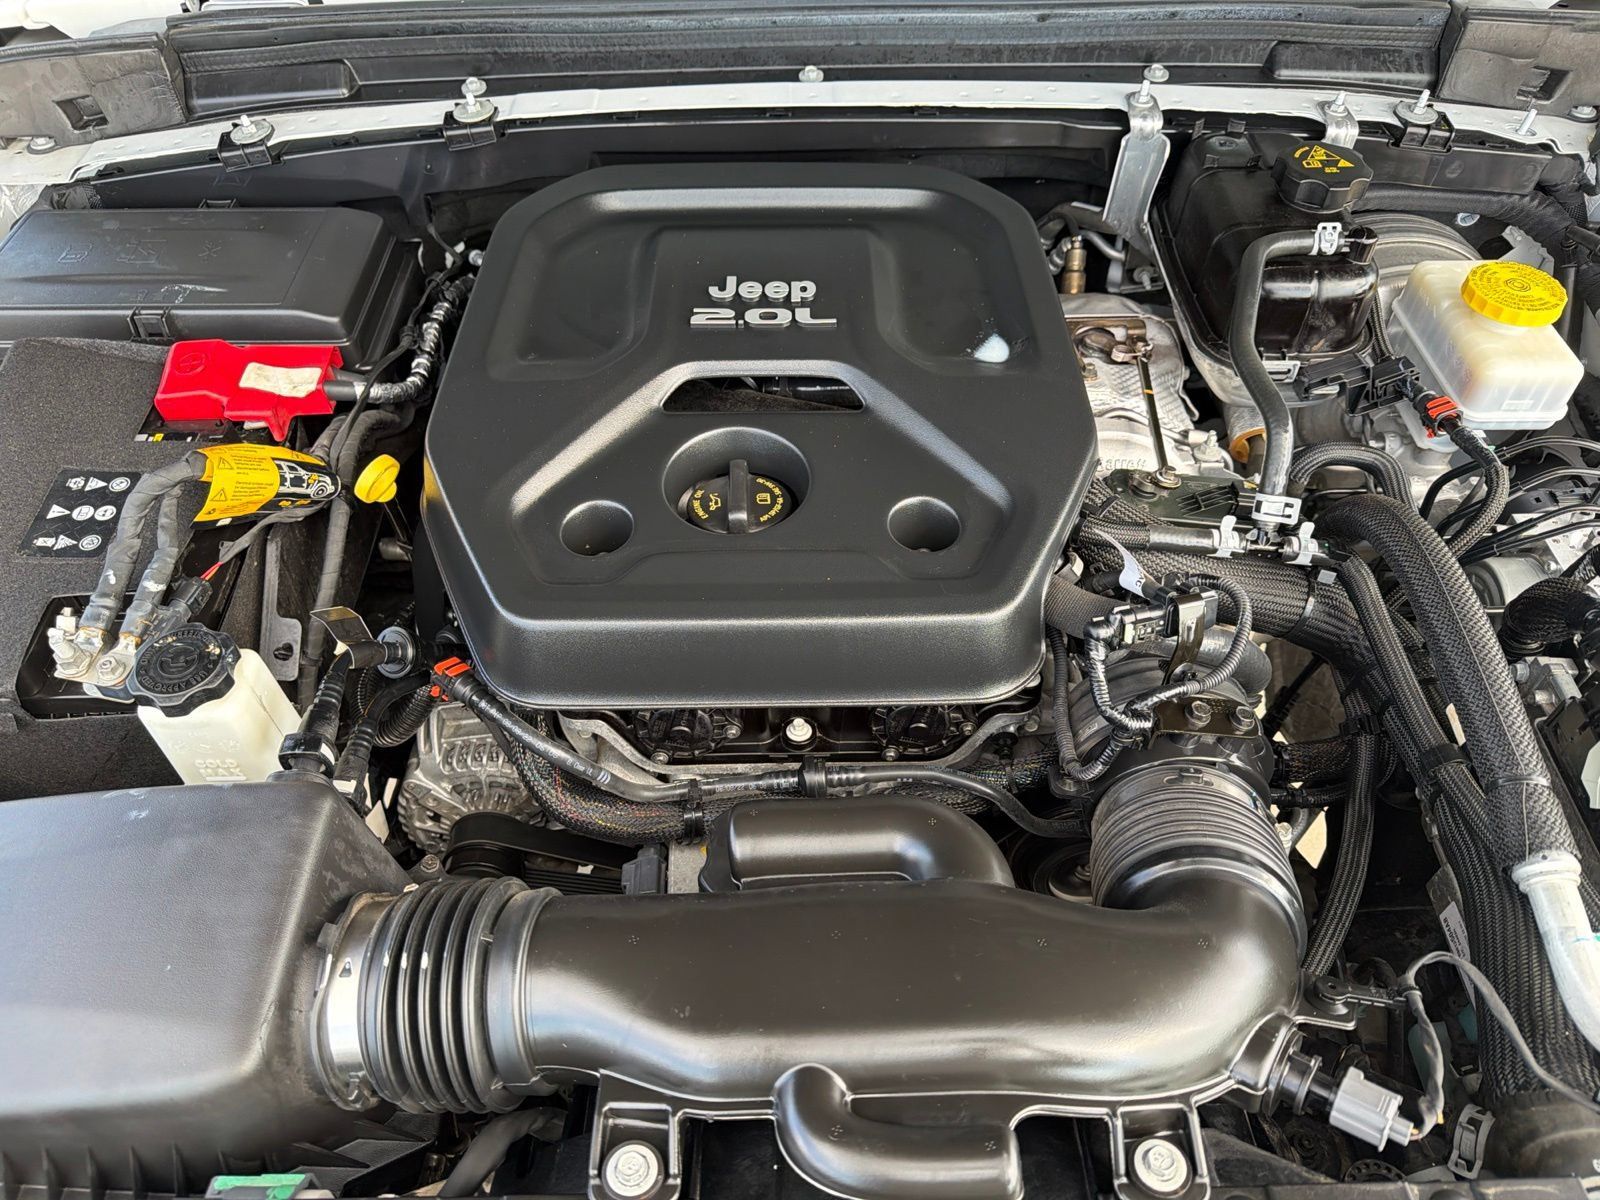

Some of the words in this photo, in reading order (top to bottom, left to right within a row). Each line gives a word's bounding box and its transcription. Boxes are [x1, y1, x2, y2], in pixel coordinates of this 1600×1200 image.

[708, 276, 817, 303] Jeep
[690, 307, 838, 328] 2.0L
[694, 489, 705, 499] OIL
[693, 500, 708, 519] ENGINE
[141, 674, 187, 692] APPROVED
[194, 759, 238, 769] COLD
[199, 768, 244, 778] MAX
